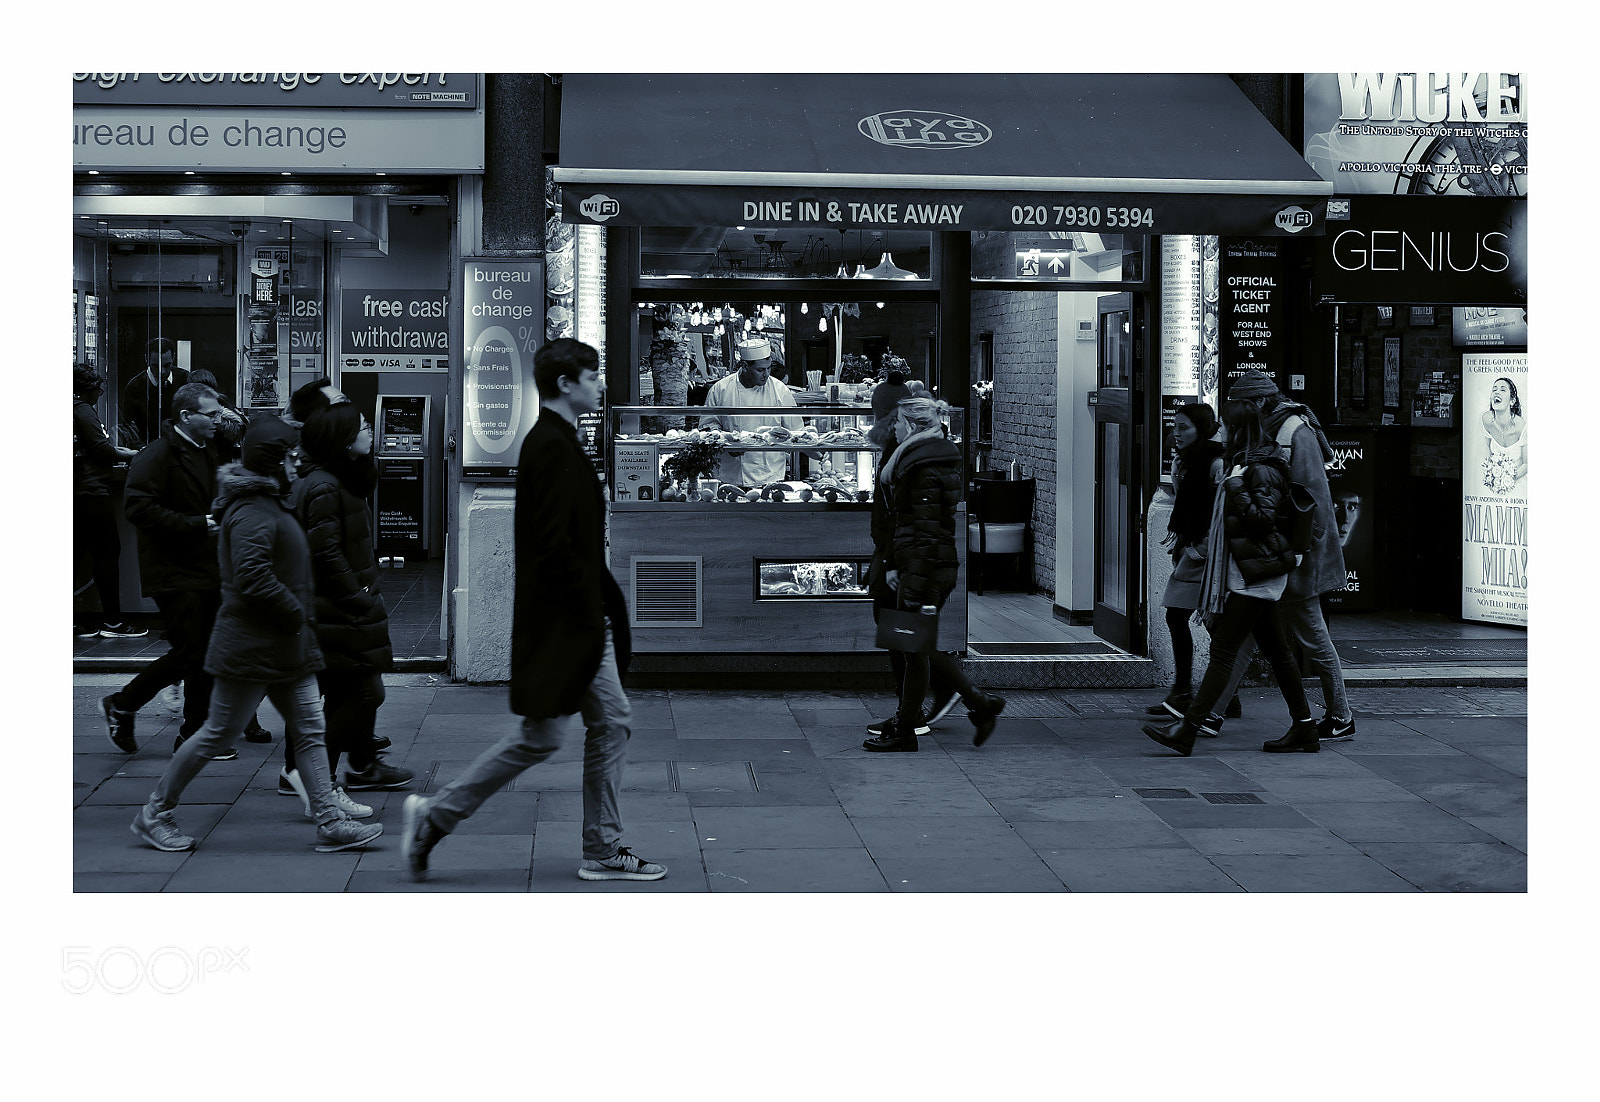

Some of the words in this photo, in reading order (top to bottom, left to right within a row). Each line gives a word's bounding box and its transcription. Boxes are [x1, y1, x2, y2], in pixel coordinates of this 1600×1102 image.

[432, 93, 465, 101] MACHINE
[168, 118, 209, 147] de
[223, 119, 347, 154] change
[1339, 124, 1360, 135] THE
[1362, 125, 1404, 136] UNTOLD
[1405, 126, 1438, 137] STORY
[1454, 128, 1473, 137] THE
[1475, 127, 1519, 138] WITCHES
[1339, 162, 1381, 173] APOLLO
[1383, 162, 1433, 173] VICTORIA
[1434, 163, 1482, 174] THEATRE
[743, 201, 792, 221] DINE
[798, 202, 820, 221] IN
[827, 202, 843, 222] &
[848, 203, 898, 223] TAKE
[903, 205, 963, 224] AWAY
[1327, 201, 1348, 213] RSC
[1011, 205, 1047, 226] 020
[1052, 206, 1101, 226] 7930
[1106, 207, 1154, 227] 5394
[1332, 229, 1510, 272] GENIUS
[474, 267, 531, 282] bureau
[1227, 276, 1277, 286] OFFICIAL
[256, 290, 273, 301] HERE
[492, 286, 513, 300] de
[1232, 290, 1271, 300] TICKET
[362, 295, 403, 317] free
[472, 302, 533, 320] change
[1233, 303, 1271, 313] AGENT
[1237, 321, 1253, 329] FOR
[1254, 321, 1269, 329] ALL
[1232, 330, 1255, 338] WEST
[1255, 330, 1272, 338] END
[473, 345, 484, 353] No
[485, 345, 514, 353] Charges
[380, 359, 401, 367] VISA
[473, 364, 491, 372] Sans
[492, 364, 509, 372] Frais
[1236, 362, 1267, 370] LONDON
[485, 402, 509, 410] gastos
[472, 420, 497, 428] Esente
[498, 420, 507, 428] da
[1331, 448, 1363, 460] MAN
[1481, 546, 1528, 590] MIA!
[1477, 598, 1504, 608] NOVELLO
